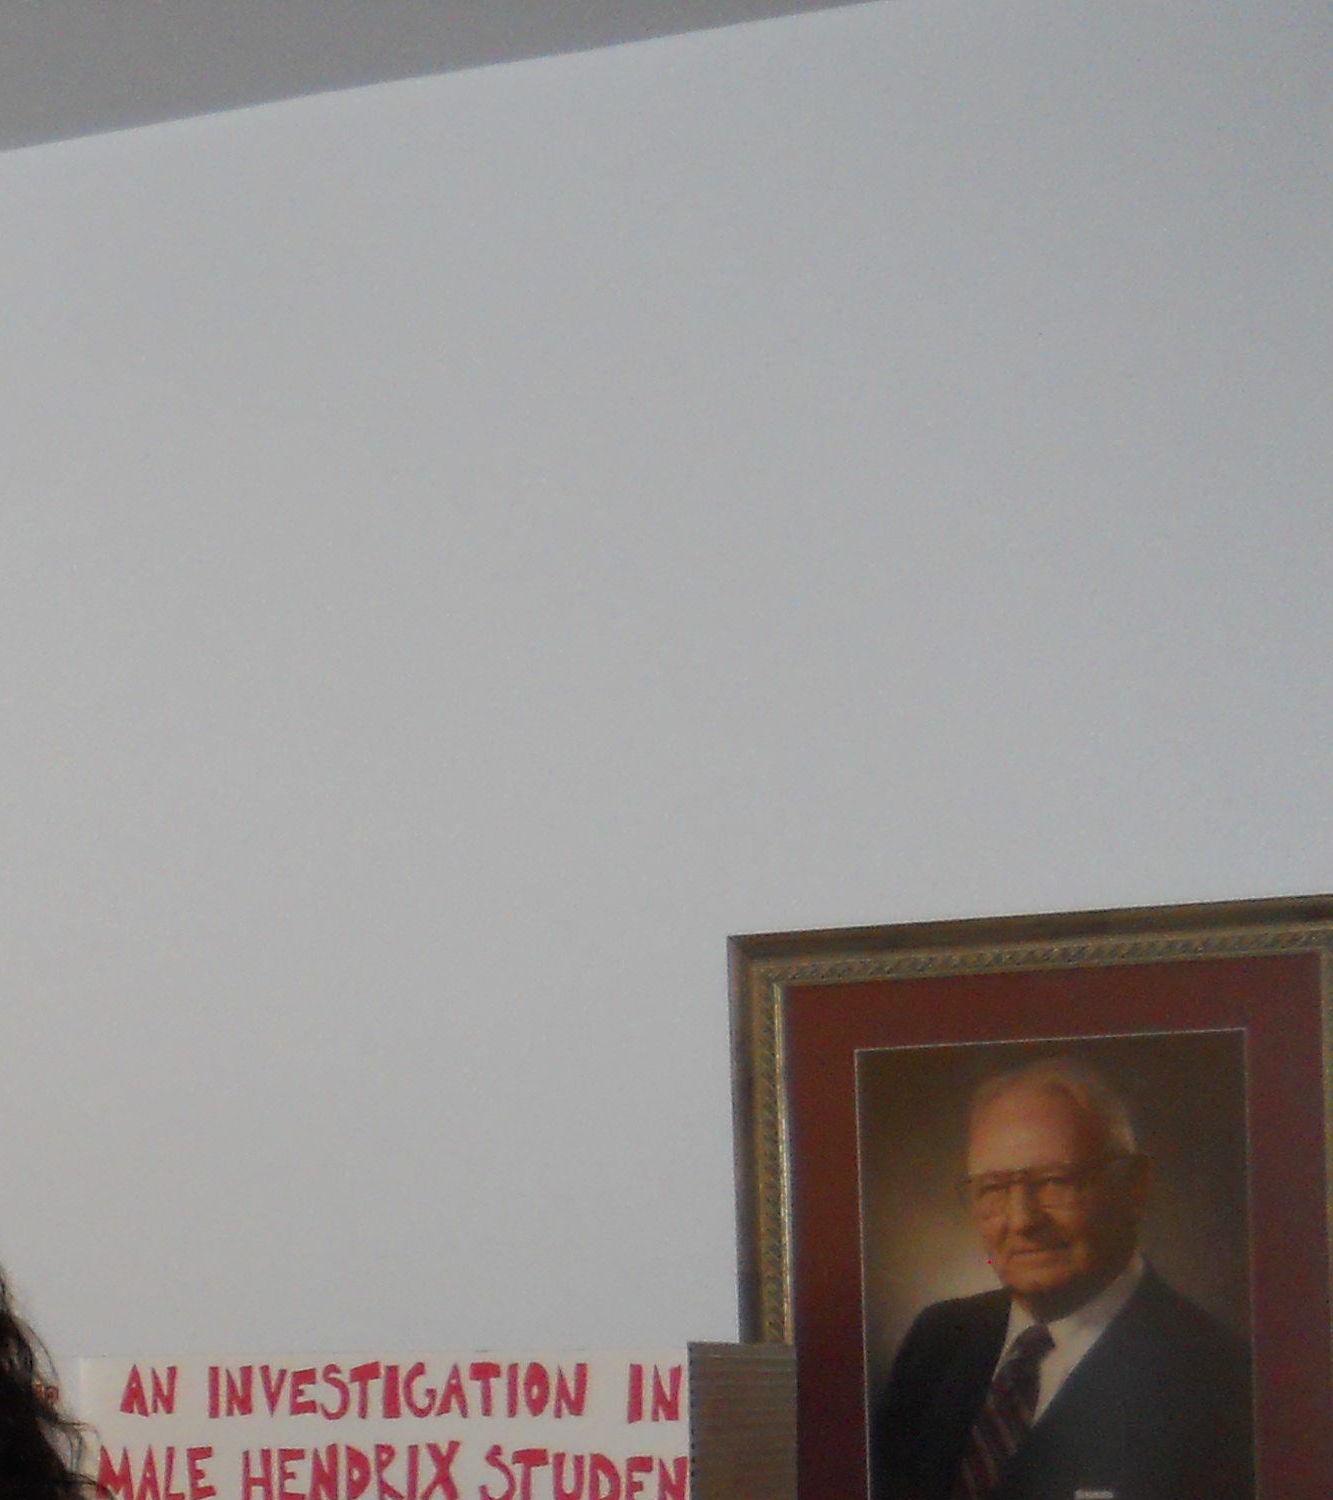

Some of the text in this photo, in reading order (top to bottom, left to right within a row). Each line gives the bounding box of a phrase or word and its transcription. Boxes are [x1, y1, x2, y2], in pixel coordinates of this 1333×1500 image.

[120, 1361, 682, 1424] AN INVESTIGATION IN
